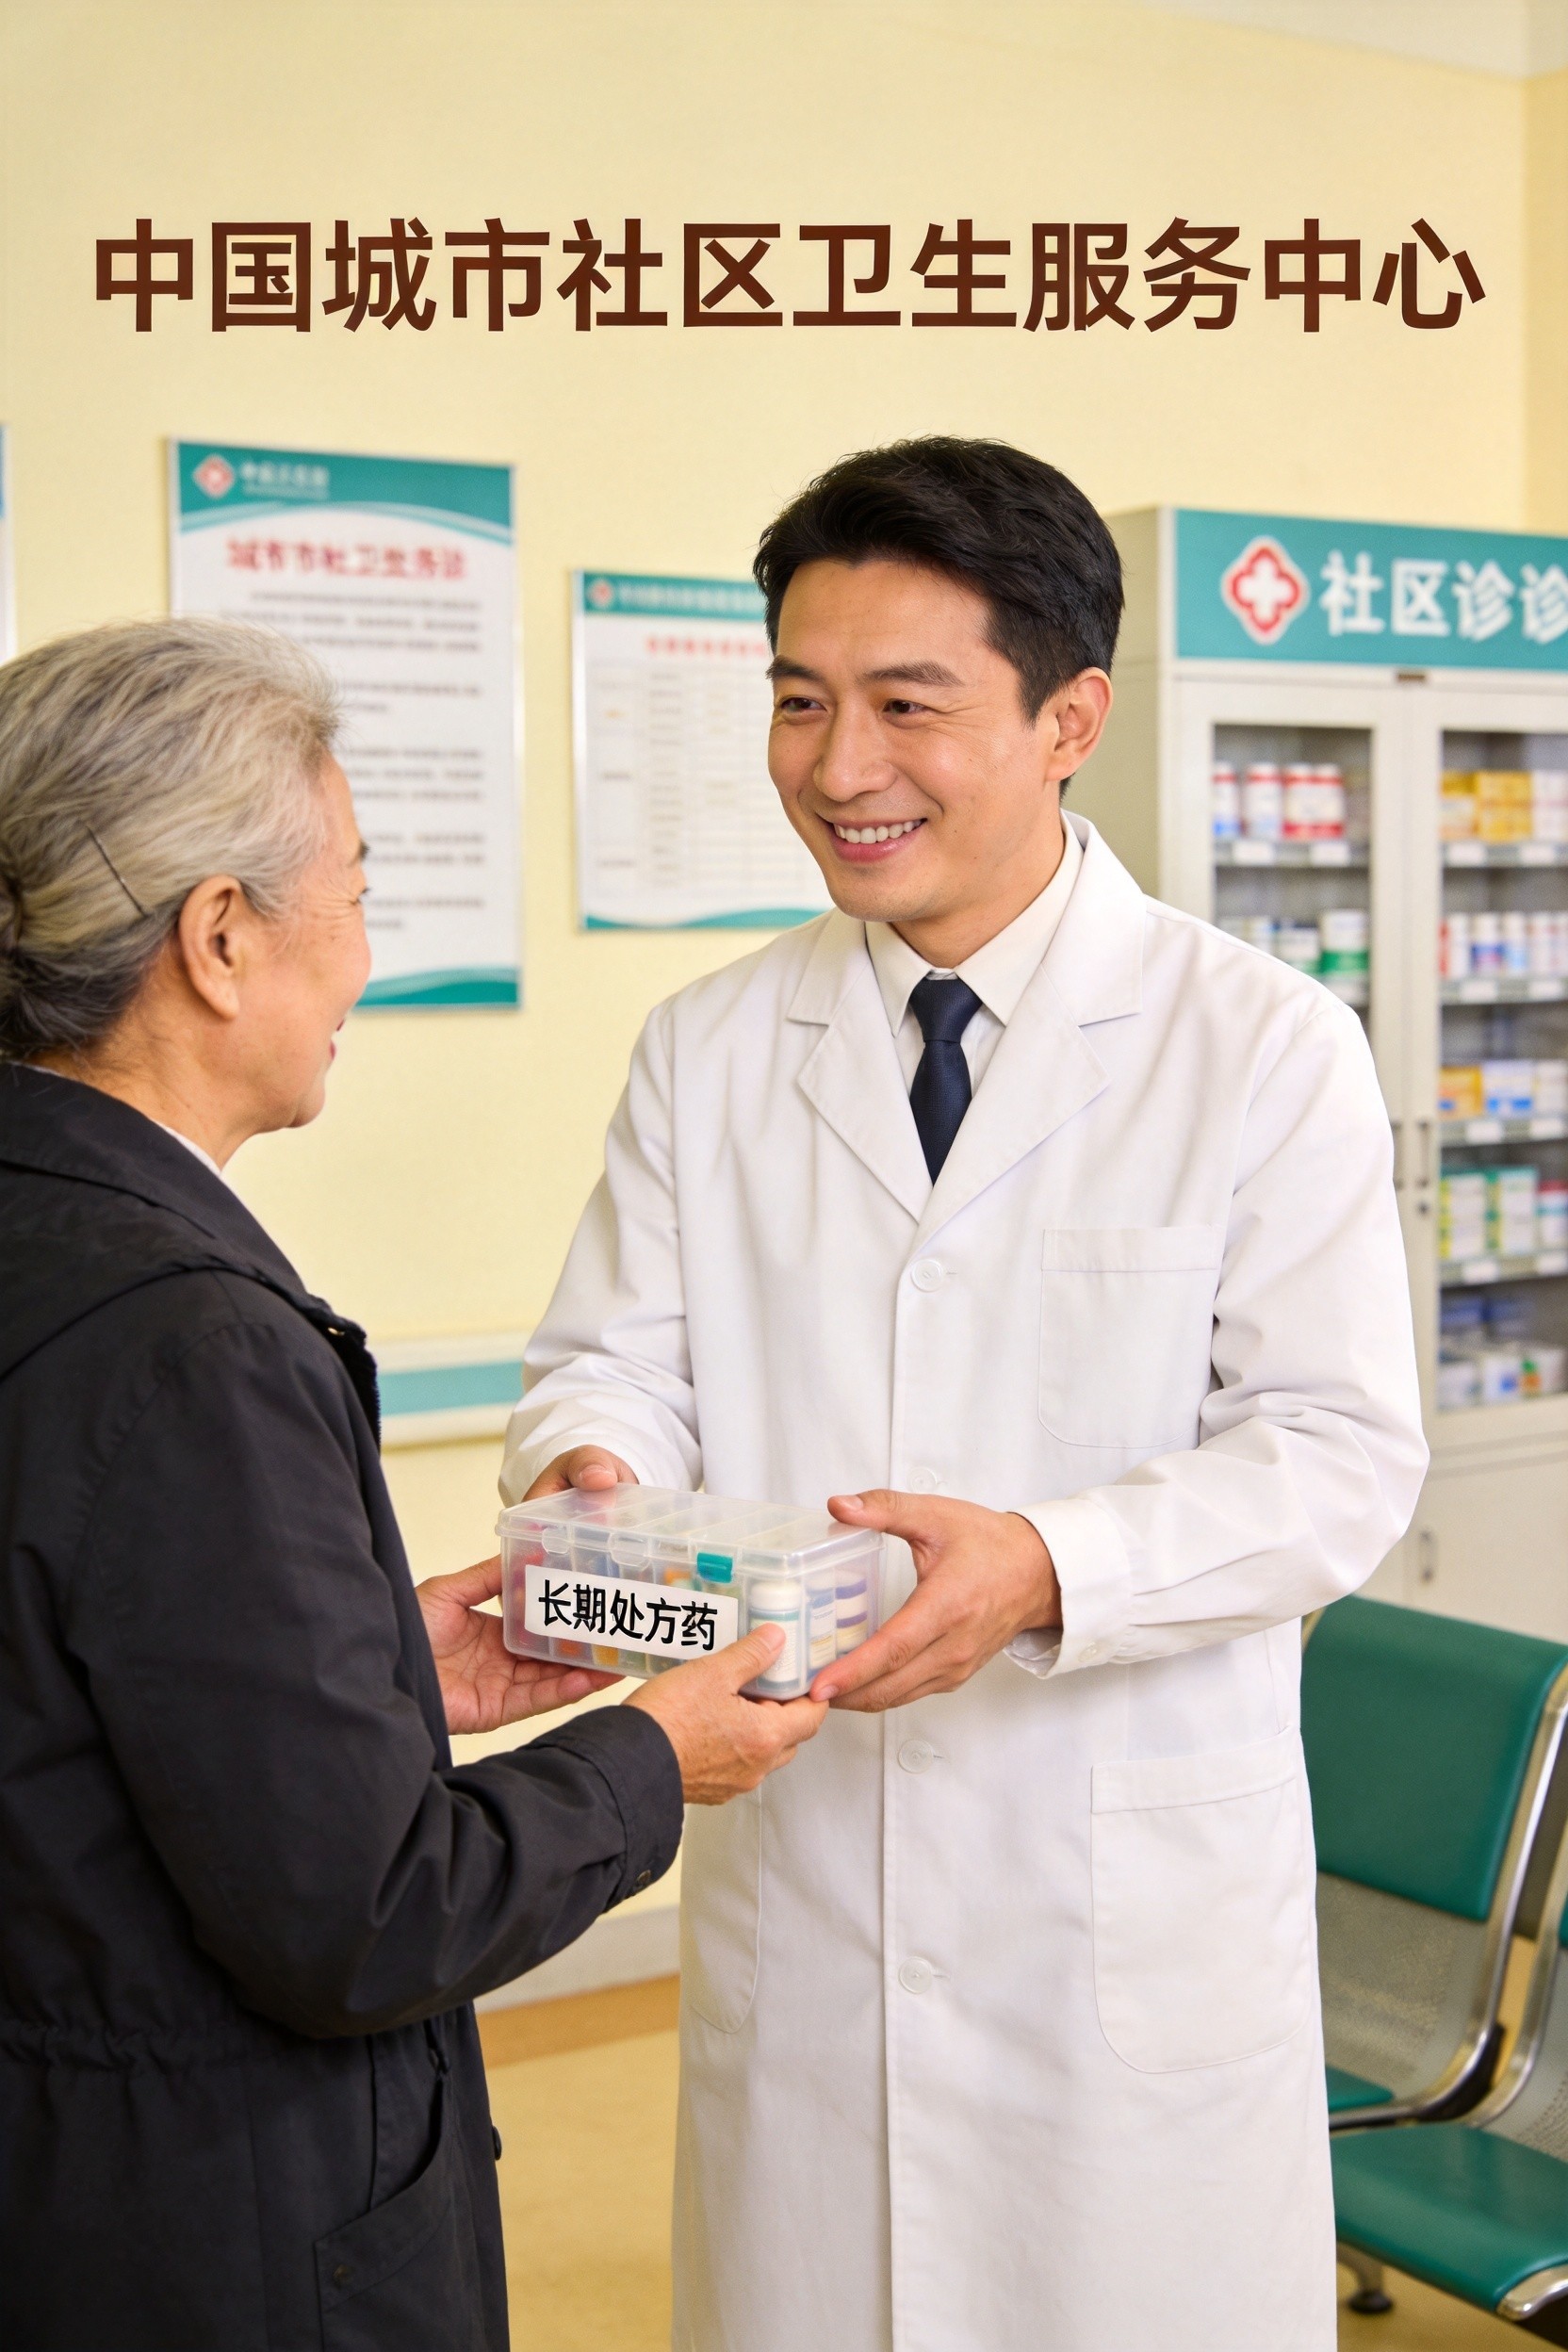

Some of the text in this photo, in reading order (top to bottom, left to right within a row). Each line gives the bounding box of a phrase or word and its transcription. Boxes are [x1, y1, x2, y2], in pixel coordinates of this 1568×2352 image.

[96, 217, 1486, 333] 中国城市社区卫生服务中心
[538, 1578, 718, 1651] 长期处方药
